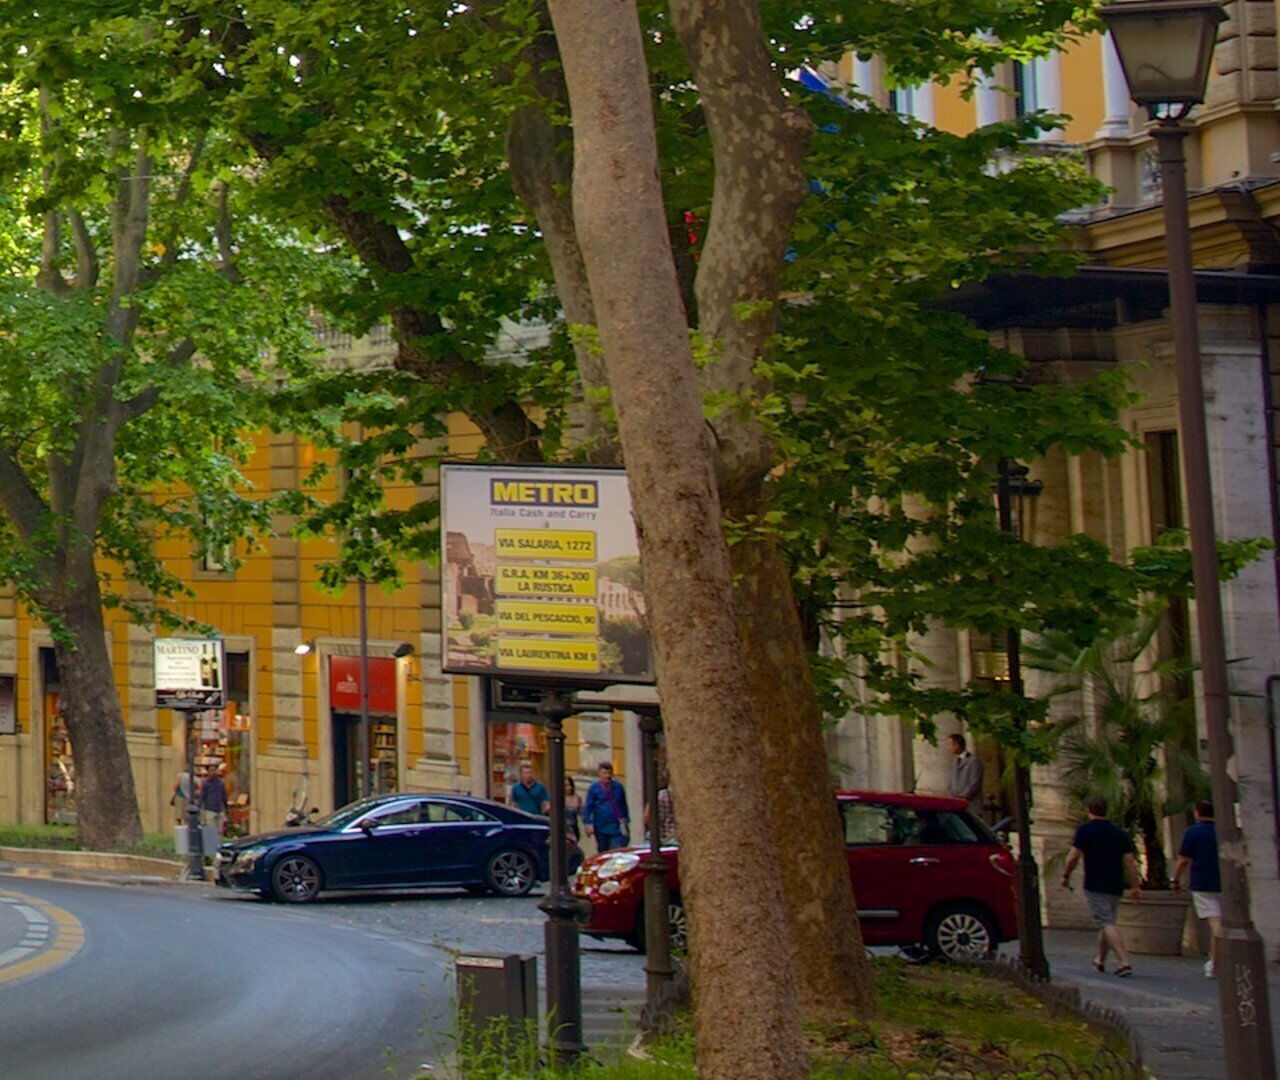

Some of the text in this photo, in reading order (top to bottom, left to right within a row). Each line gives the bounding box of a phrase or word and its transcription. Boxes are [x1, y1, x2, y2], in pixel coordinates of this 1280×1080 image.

[493, 481, 596, 505] METRO
[491, 508, 596, 520] Italia Cash and Carry
[498, 538, 592, 551] VIA SALARIA, 1272
[533, 569, 548, 580] KM
[517, 582, 575, 593] LA RUSTICA
[499, 611, 513, 621] VIA
[515, 611, 531, 622] DEL
[156, 645, 200, 655] MARTINO
[499, 648, 514, 658] VIA
[516, 649, 572, 661] LAURENTINA
[574, 651, 589, 661] KM
